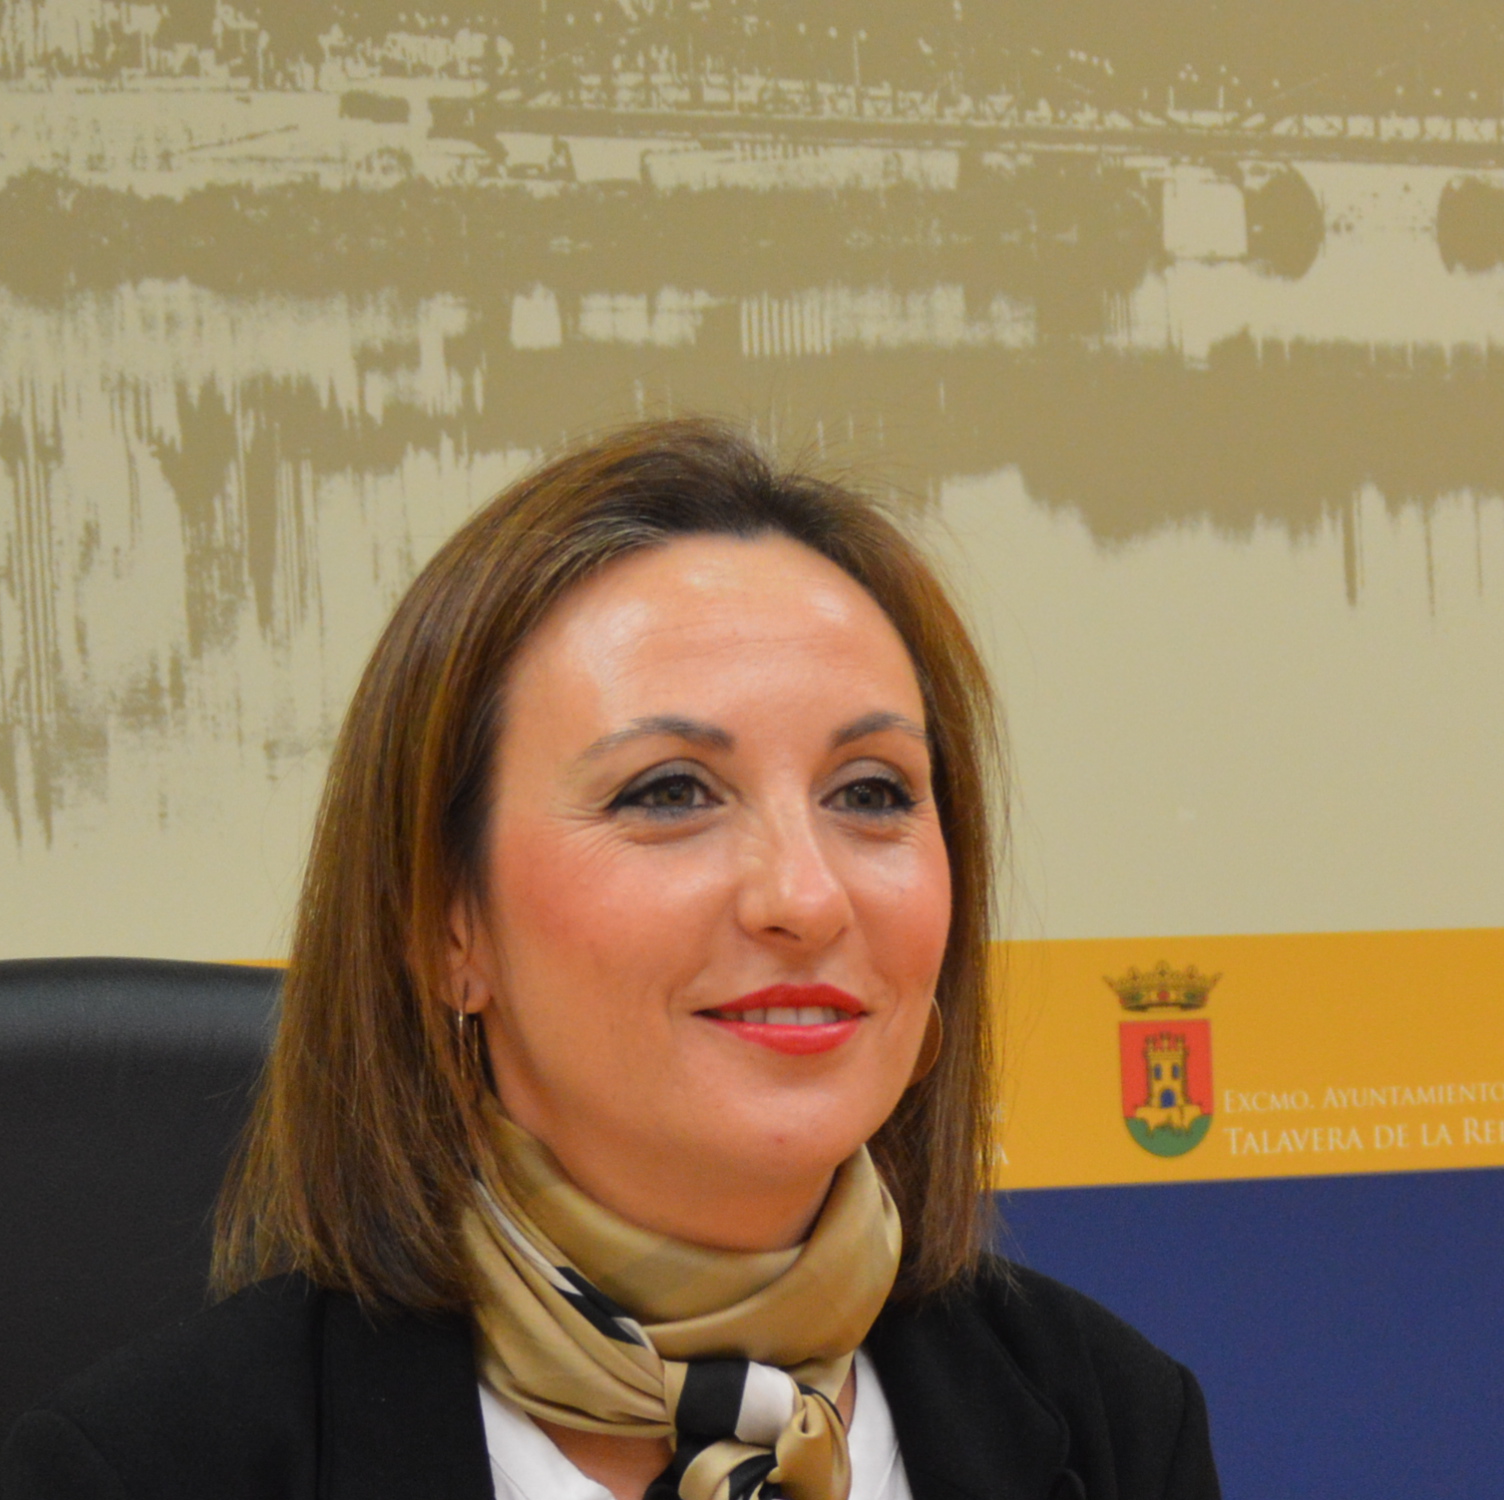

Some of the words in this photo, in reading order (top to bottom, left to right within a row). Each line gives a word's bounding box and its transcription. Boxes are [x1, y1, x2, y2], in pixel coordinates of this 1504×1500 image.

[1223, 1089, 1315, 1114] EXCMO.
[1223, 1126, 1365, 1156] TALAVERA
[1374, 1123, 1410, 1150] DE
[1421, 1122, 1454, 1147] LA
